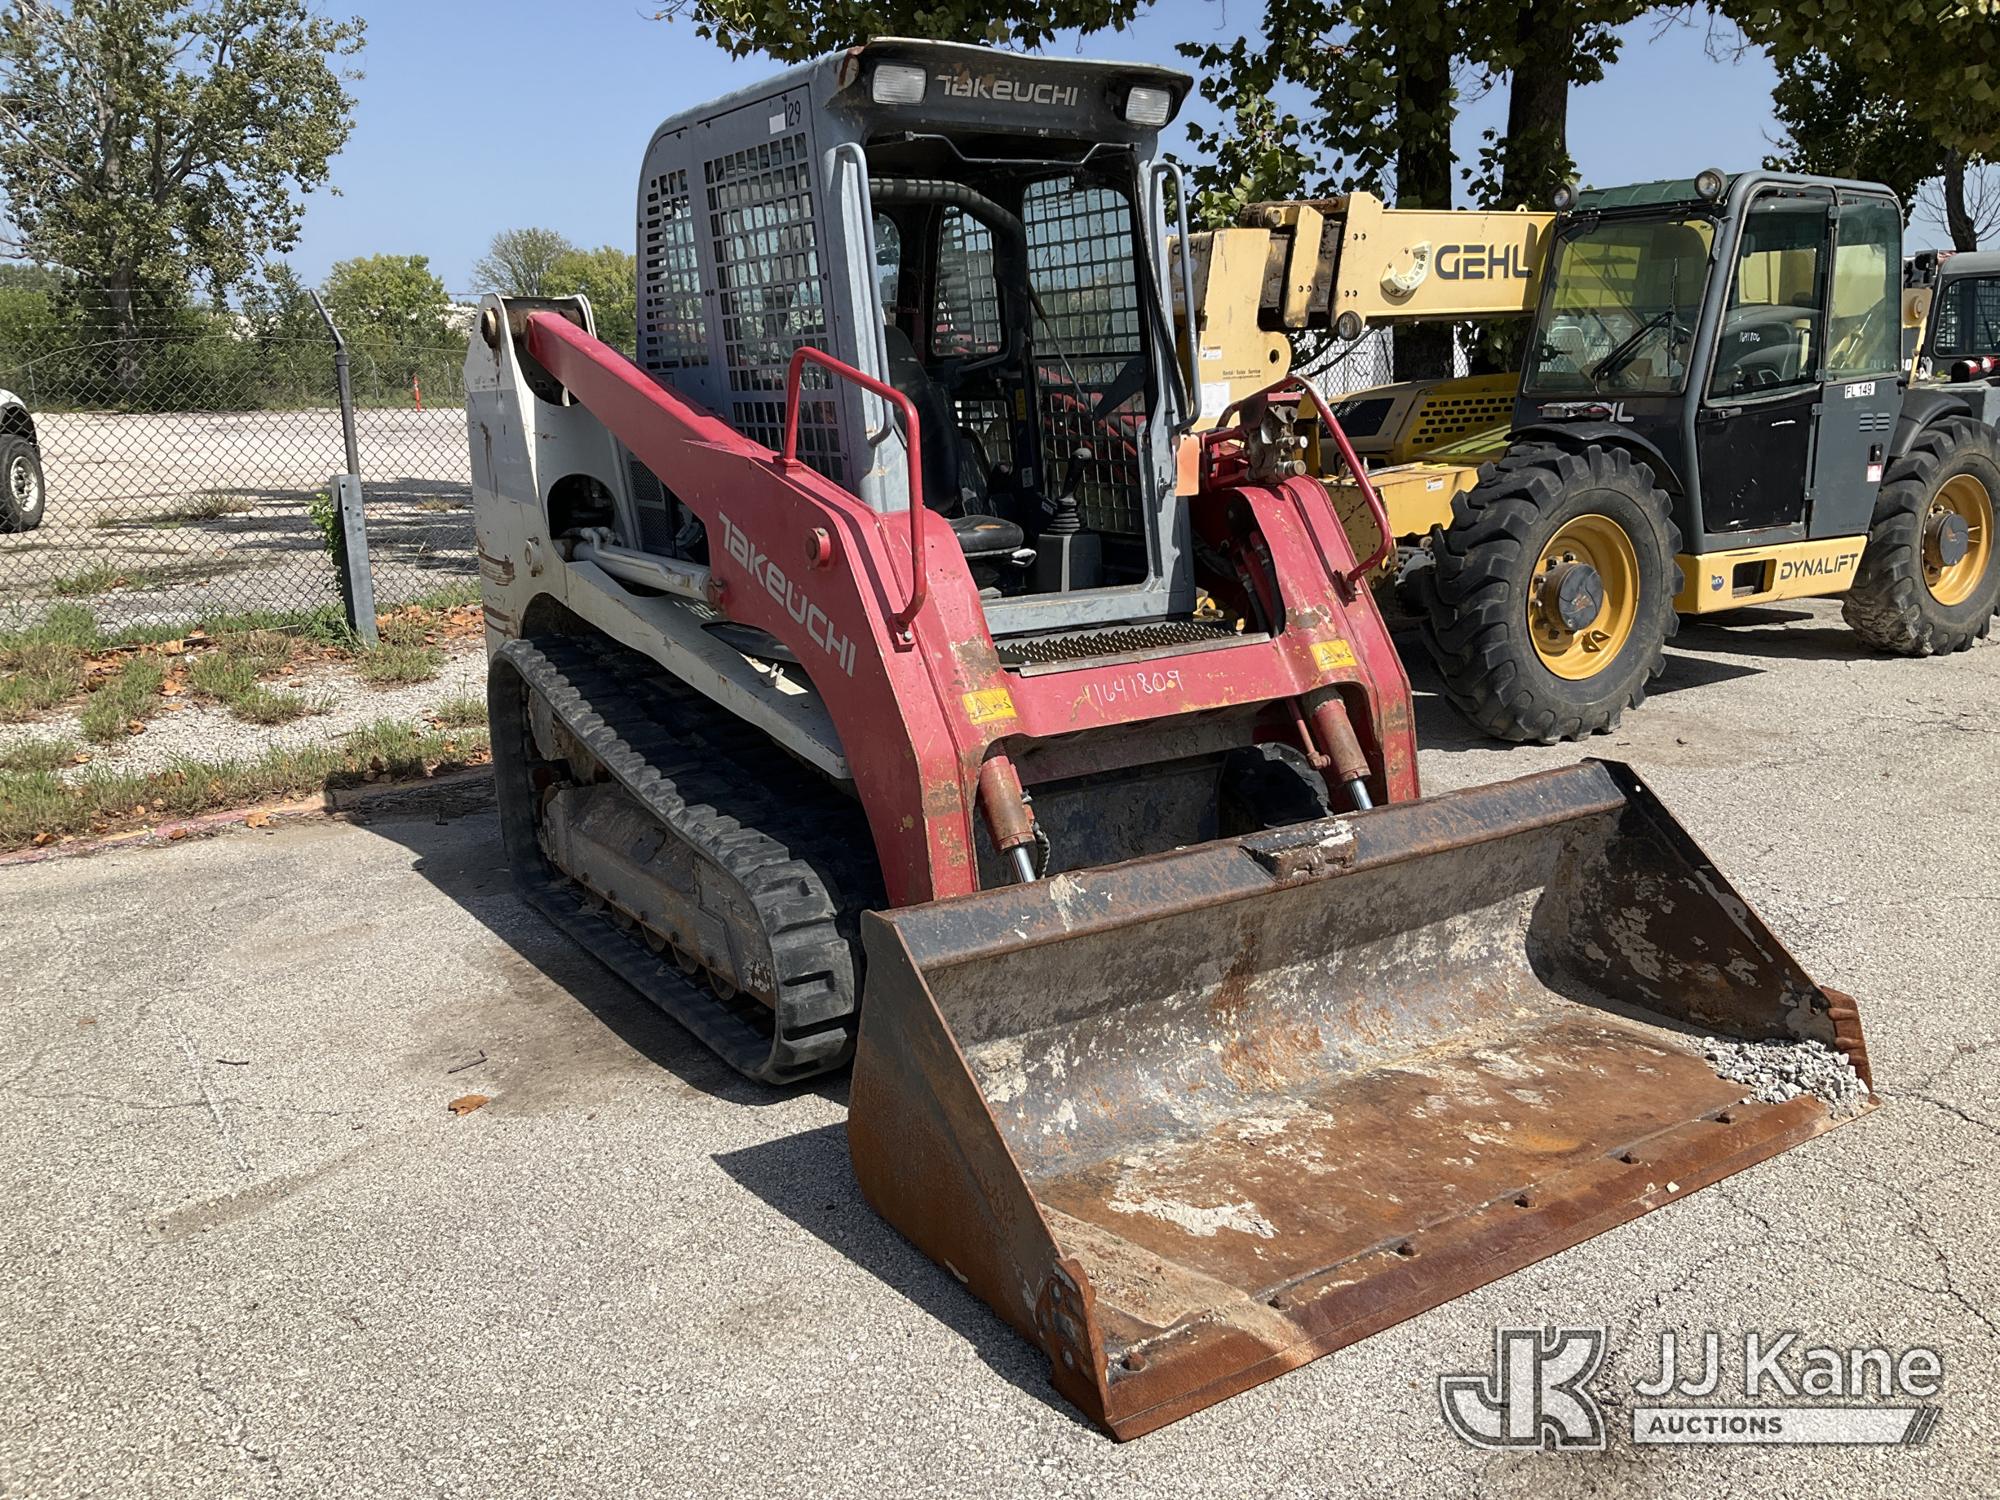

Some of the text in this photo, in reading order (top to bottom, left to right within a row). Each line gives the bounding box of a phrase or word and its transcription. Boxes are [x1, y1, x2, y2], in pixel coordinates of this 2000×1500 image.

[784, 99, 801, 128] 129
[1171, 240, 1206, 258] GHL
[1434, 243, 1533, 280] GEHL
[1846, 383, 1872, 397] FL 149
[1779, 553, 1858, 581] DYNALIFT
[718, 511, 856, 678] TAKEUCHI
[1093, 670, 1184, 706] 1641809
